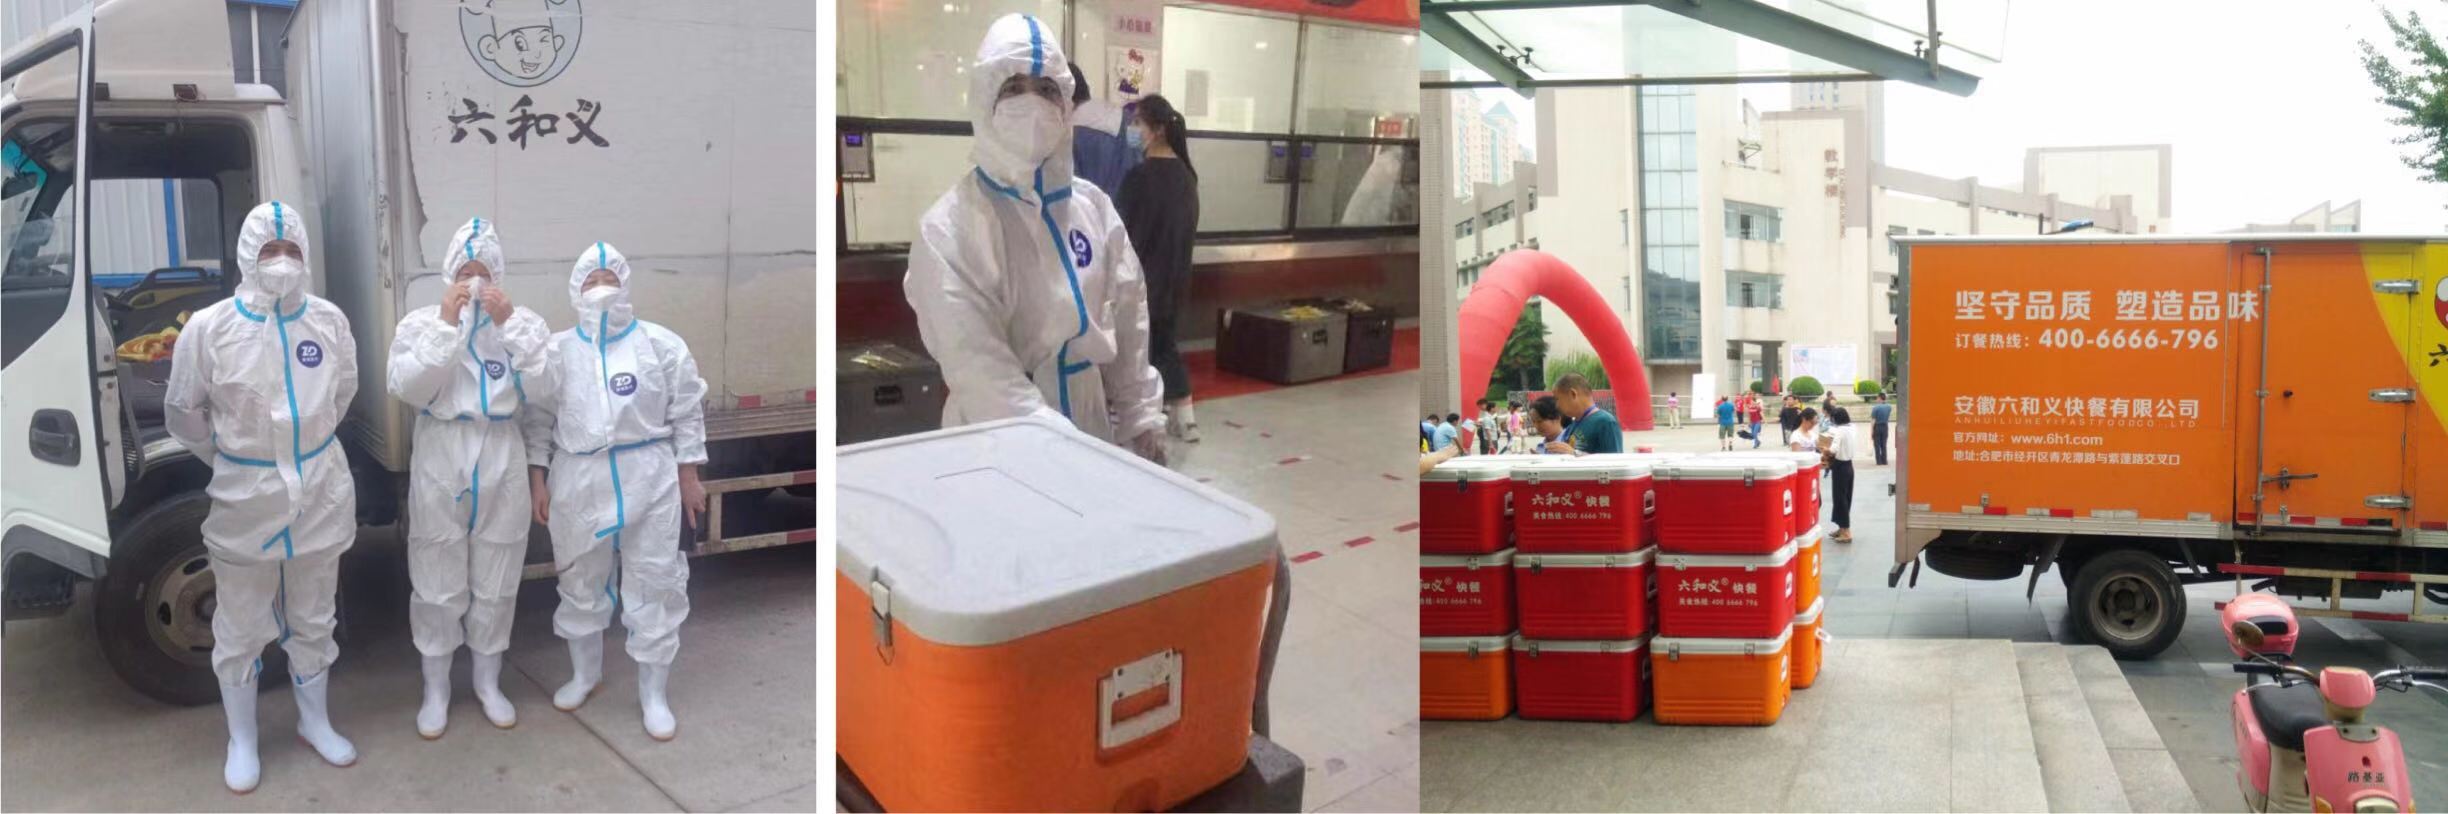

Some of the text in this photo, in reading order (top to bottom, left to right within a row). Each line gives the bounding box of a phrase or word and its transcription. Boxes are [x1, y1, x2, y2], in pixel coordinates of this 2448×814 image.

[447, 94, 610, 151] 六和义
[1955, 290, 2260, 322] 坚守品质 塑造品味
[2038, 328, 2218, 350] 400-6666-796
[1954, 395, 2200, 420] 安徽六和义快餐有限公司
[2010, 433, 2103, 446] www.6h1.com
[1531, 492, 1575, 508] 六和义
[1677, 578, 1722, 593] 六和义
